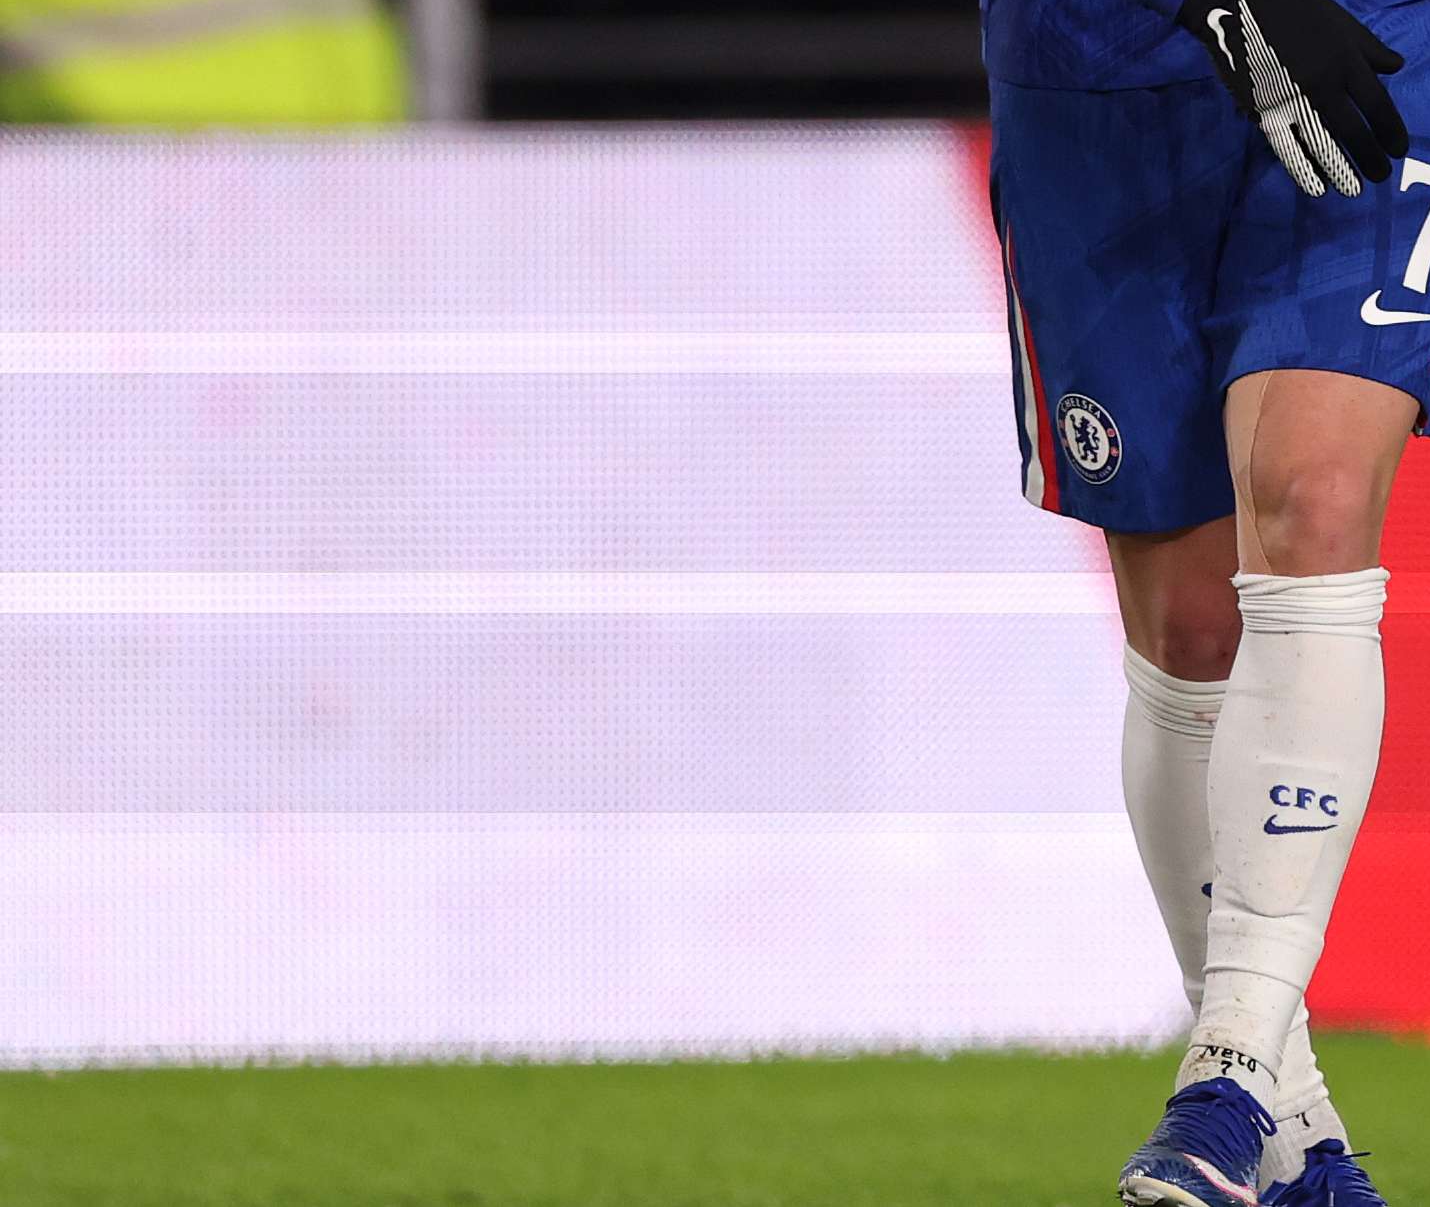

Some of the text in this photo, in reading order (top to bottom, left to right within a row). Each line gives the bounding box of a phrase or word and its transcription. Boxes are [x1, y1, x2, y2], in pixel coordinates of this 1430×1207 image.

[1061, 397, 1101, 419] CHELSEA
[1269, 784, 1339, 817] CFC
[1220, 1060, 1233, 1075] 7
